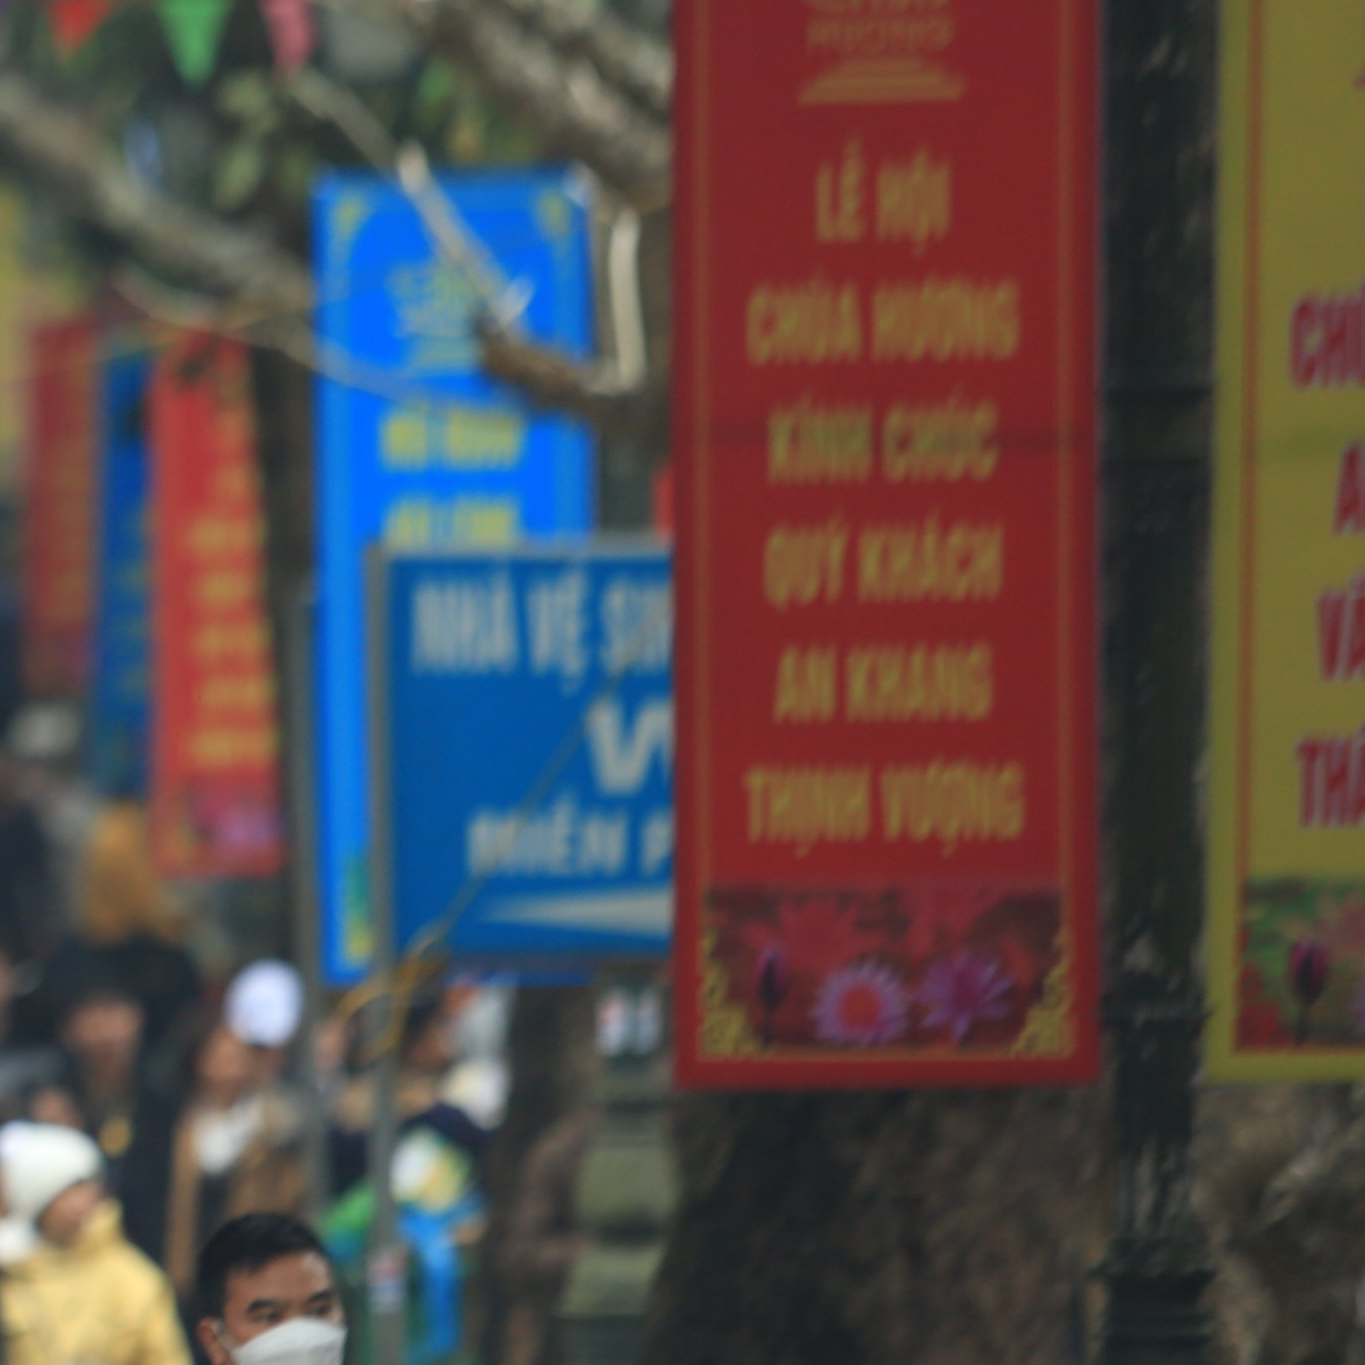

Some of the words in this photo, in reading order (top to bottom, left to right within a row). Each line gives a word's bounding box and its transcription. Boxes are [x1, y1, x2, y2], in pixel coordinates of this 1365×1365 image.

[858, 507, 1004, 602] KHÁCH
[775, 645, 836, 725] AN
[846, 644, 992, 724] KHANG
